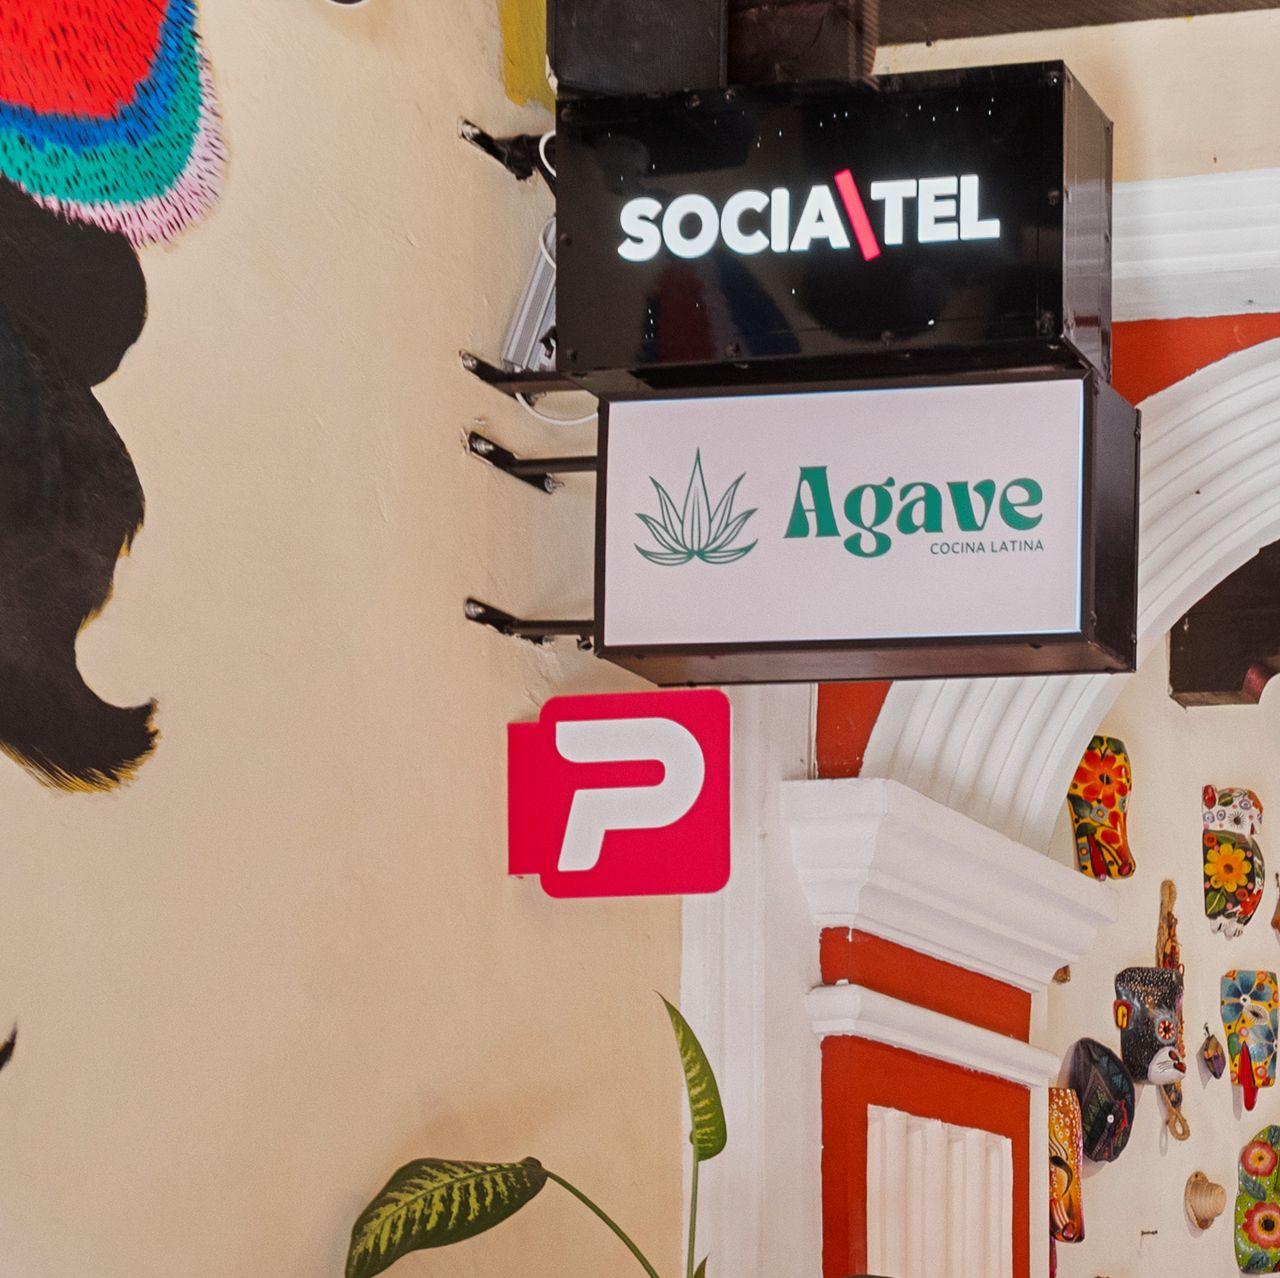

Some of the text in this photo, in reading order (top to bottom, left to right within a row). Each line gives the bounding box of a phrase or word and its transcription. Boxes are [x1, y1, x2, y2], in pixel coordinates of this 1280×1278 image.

[617, 168, 1001, 262] SOCIA\TEL
[783, 465, 1044, 559] Agave
[930, 538, 1045, 556] COCINA LATINA
